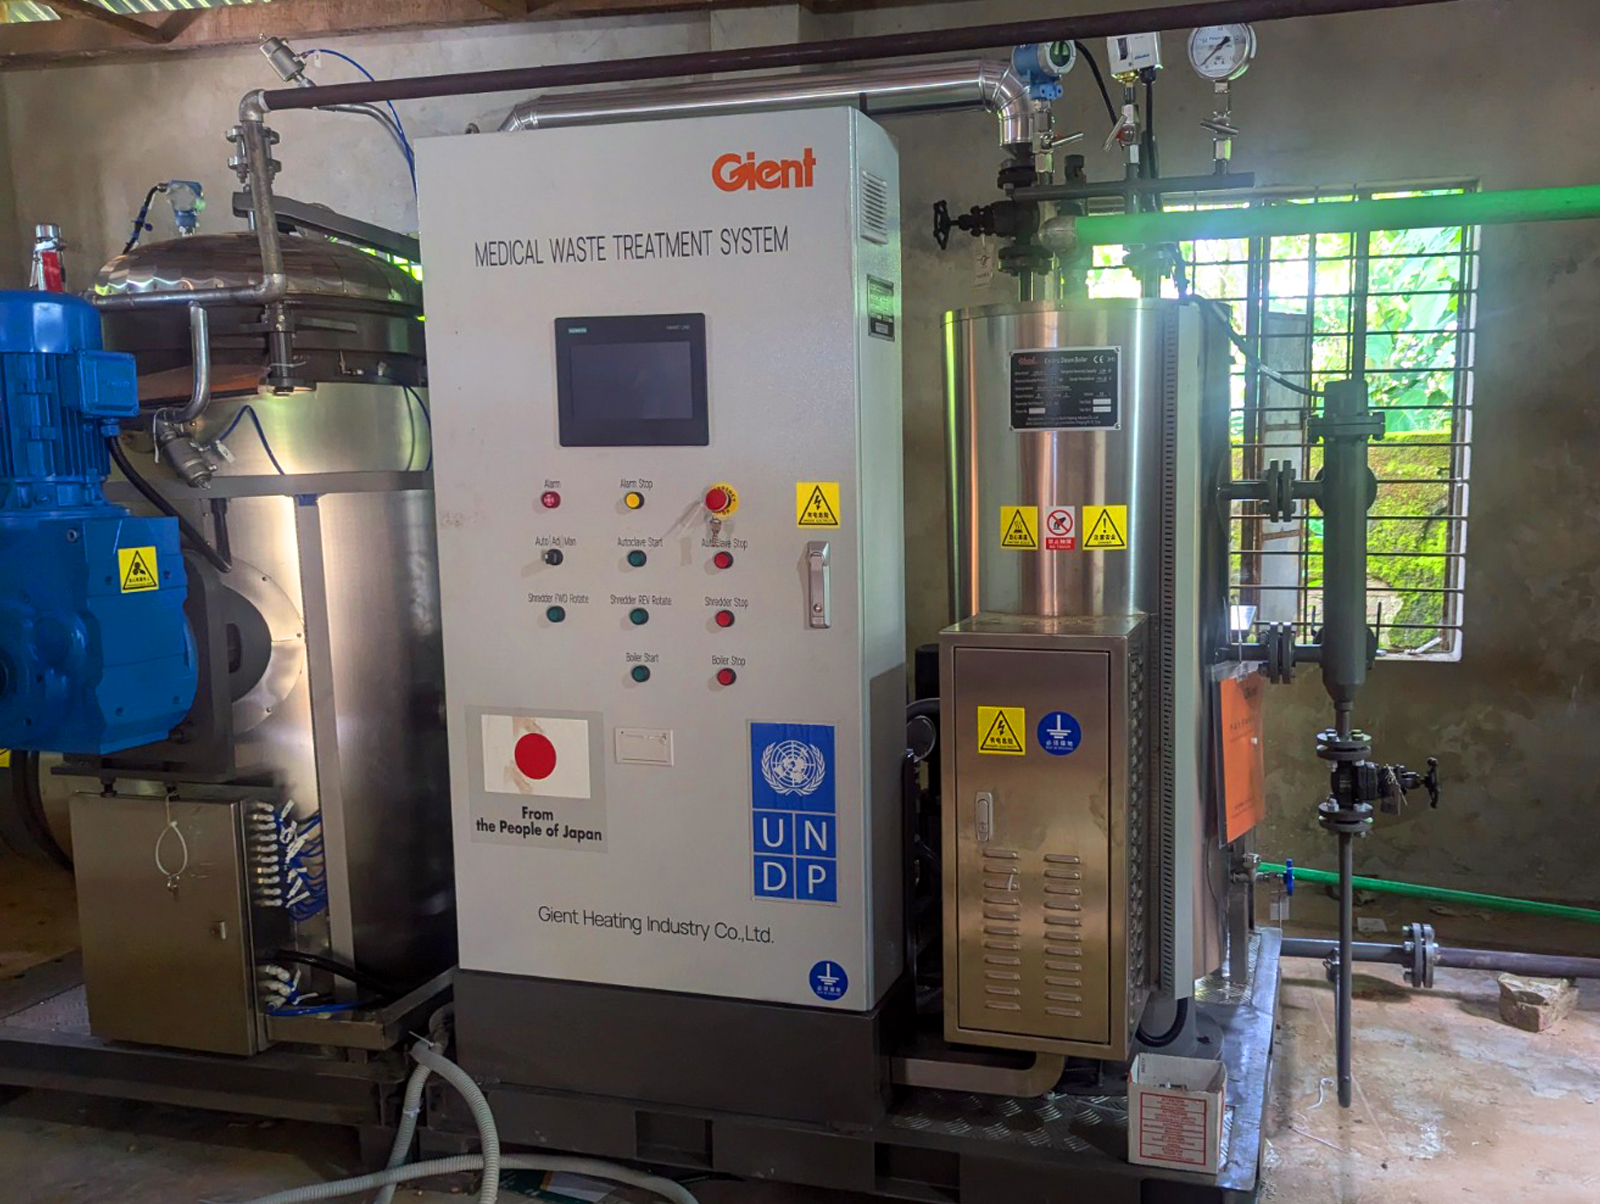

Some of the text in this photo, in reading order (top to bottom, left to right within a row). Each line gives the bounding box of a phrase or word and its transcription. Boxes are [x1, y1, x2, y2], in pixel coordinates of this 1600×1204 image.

[711, 147, 817, 192] Gient
[474, 225, 789, 267] MEDICAL WASTE TREATMENT SYSTEM
[544, 480, 562, 488] Alarm
[620, 479, 653, 490] Alarm Stop
[617, 537, 663, 547] Autoclave Start
[733, 538, 748, 550] Stop
[528, 593, 553, 603] Shredder
[569, 594, 589, 604] Rotate
[610, 594, 672, 606] Shredder REV Rotate
[705, 597, 749, 609] Shredder Stop
[626, 652, 659, 663] Boiler Start
[711, 655, 746, 668] Boiler Stop
[521, 806, 554, 821] From
[476, 817, 602, 843] the People of Japan
[538, 905, 775, 944] Gient Heating Industry Co.,Ltd.
